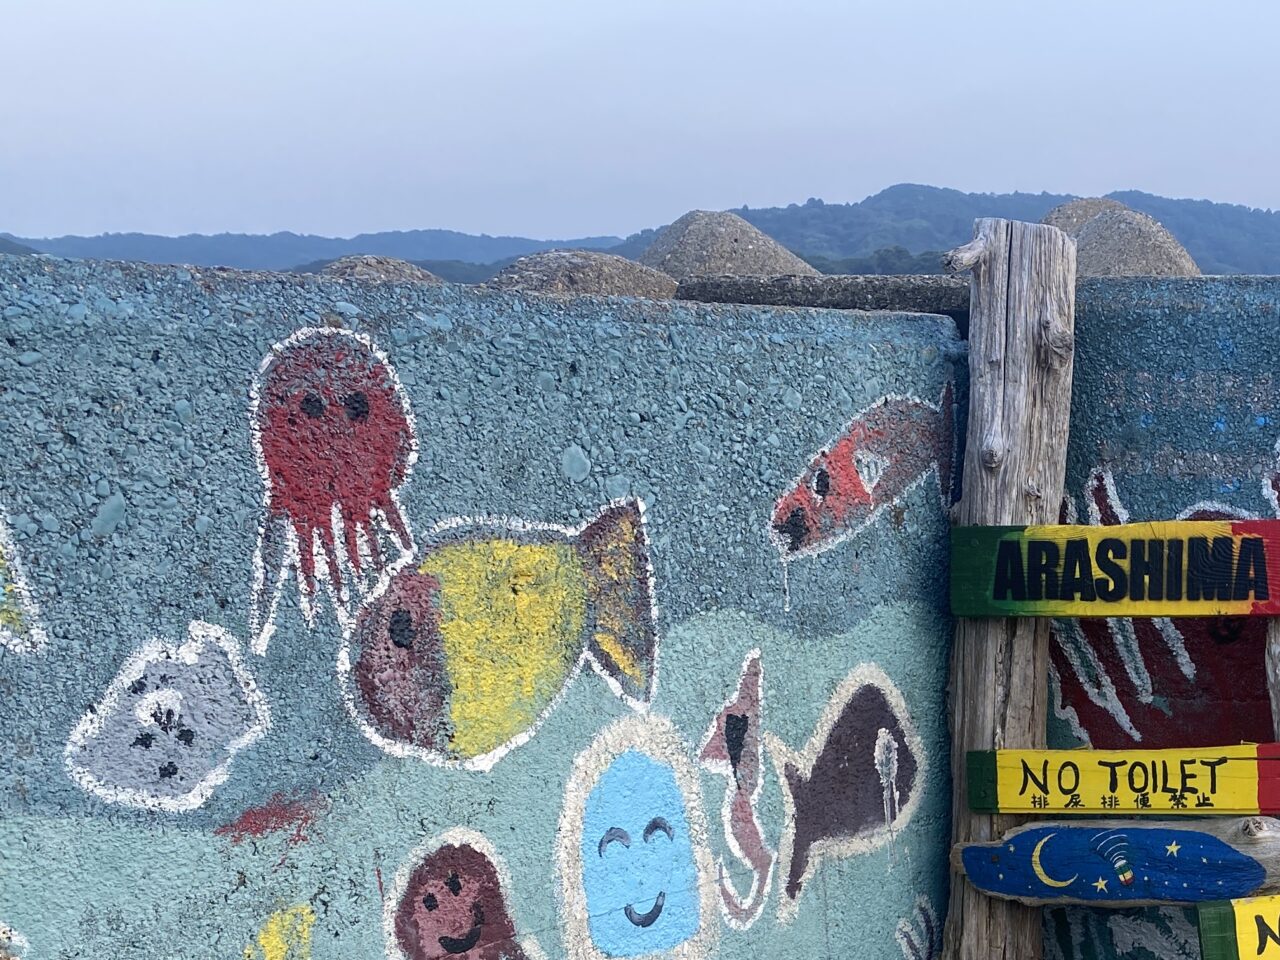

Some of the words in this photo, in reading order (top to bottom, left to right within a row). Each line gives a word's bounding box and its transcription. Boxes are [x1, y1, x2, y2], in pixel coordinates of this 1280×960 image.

[993, 537, 1270, 601] ARASHIMA
[1019, 759, 1081, 796] NO
[1098, 756, 1228, 795] TOILET
[1031, 792, 1215, 809] 排尿排便禁止
